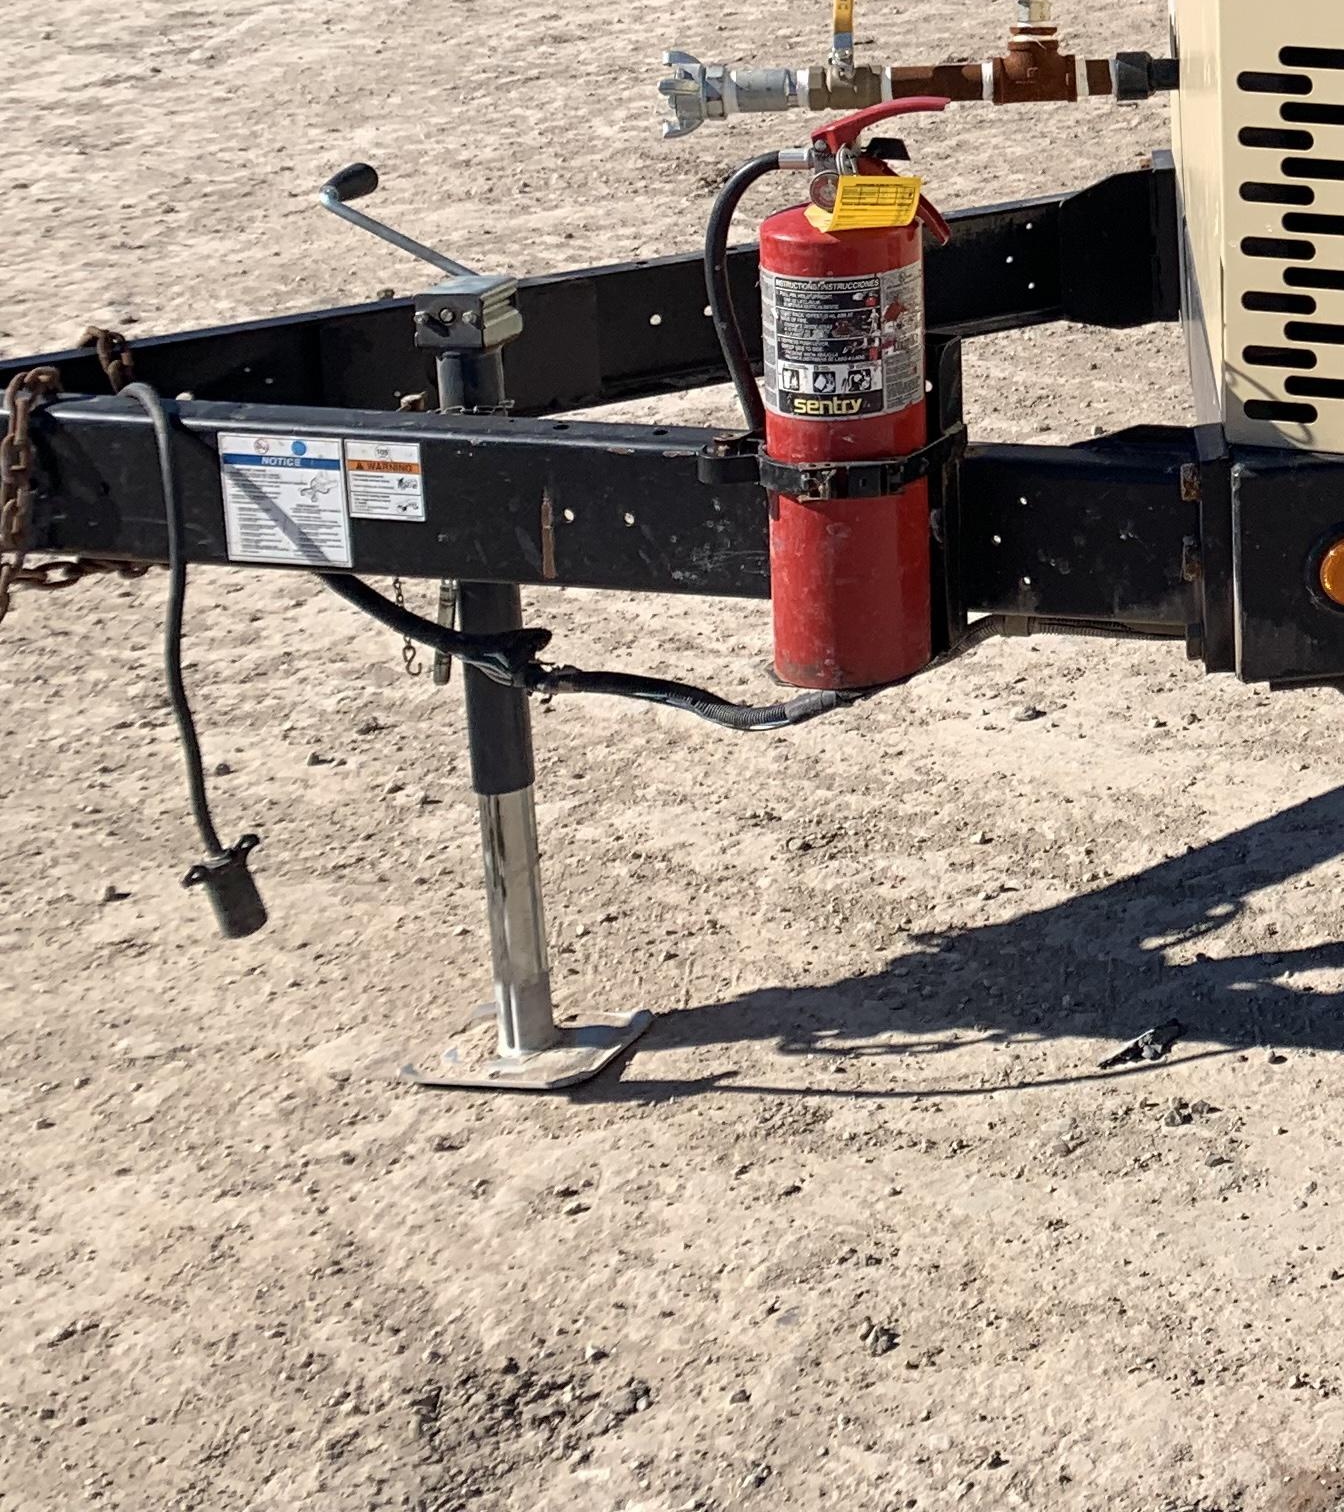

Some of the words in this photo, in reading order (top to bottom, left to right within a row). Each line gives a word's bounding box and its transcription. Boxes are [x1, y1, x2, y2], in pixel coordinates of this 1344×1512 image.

[793, 396, 863, 415] sentry
[261, 456, 302, 467] NOTICE
[367, 462, 412, 471] WARNING
